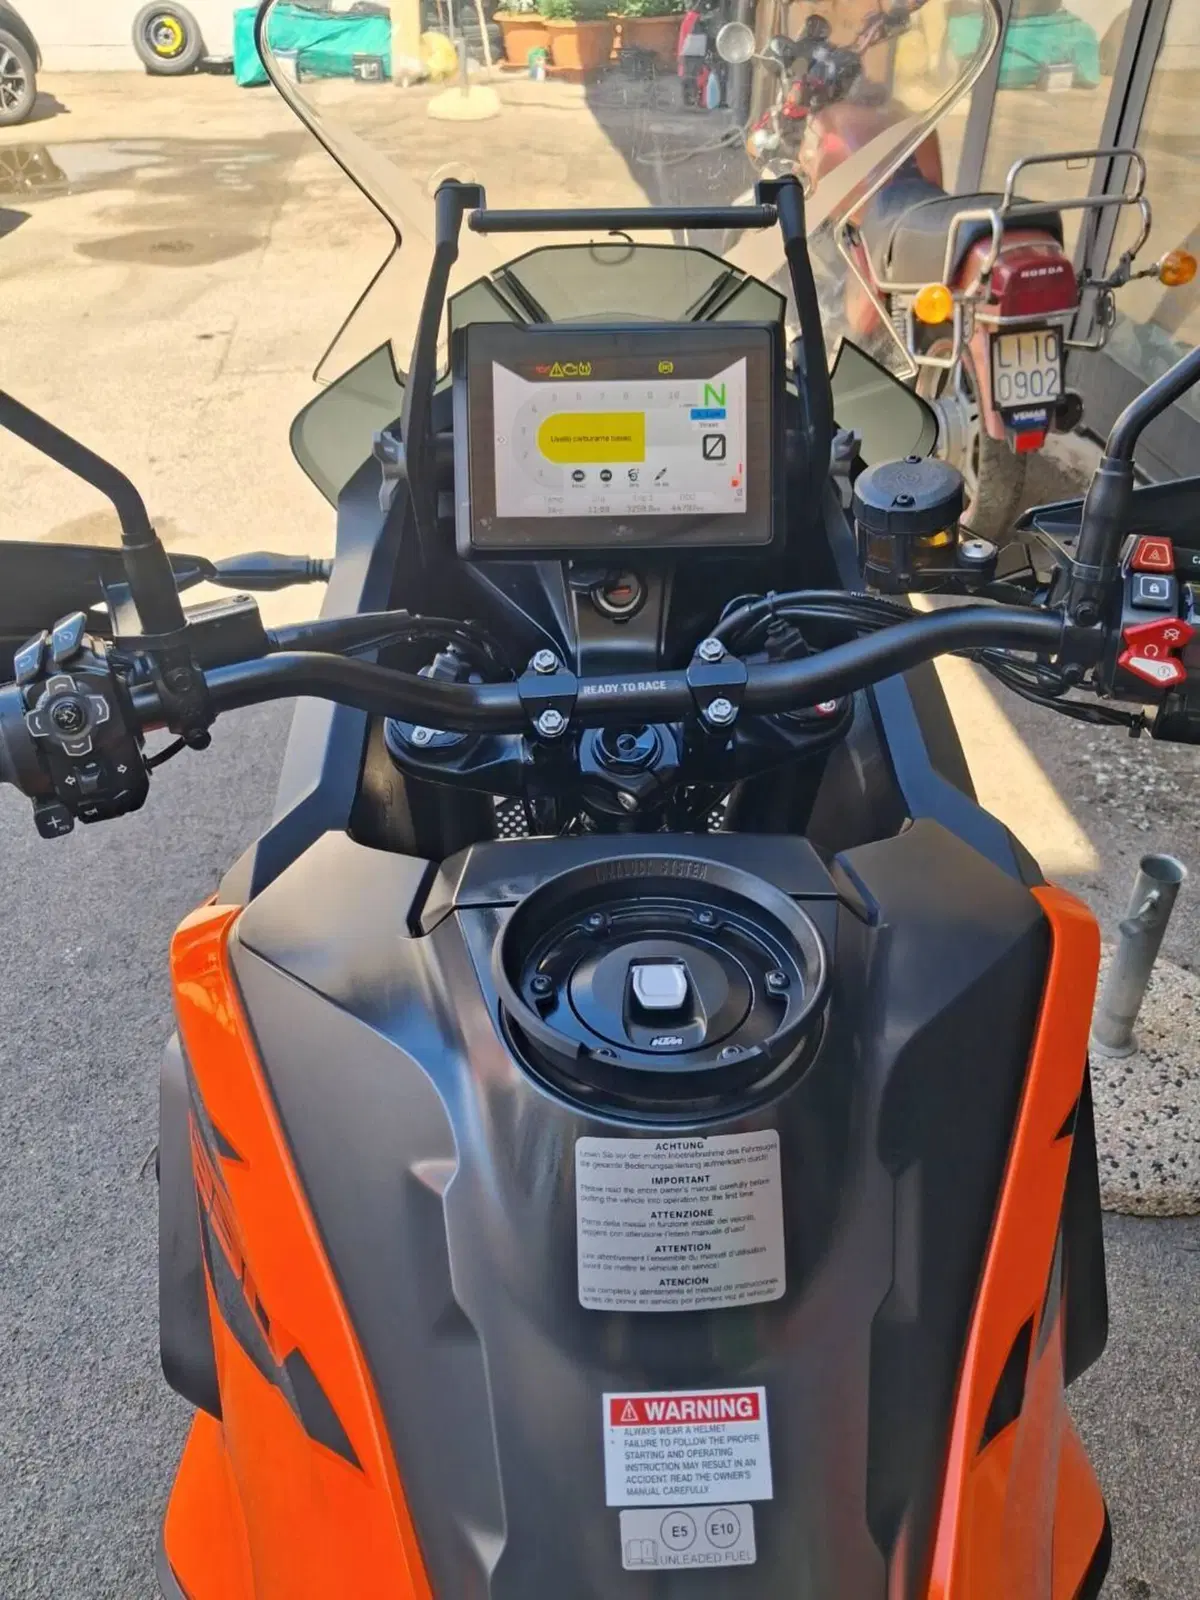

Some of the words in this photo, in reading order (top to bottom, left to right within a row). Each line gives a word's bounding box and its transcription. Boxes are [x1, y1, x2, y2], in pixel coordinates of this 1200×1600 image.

[1020, 266, 1064, 278] HONDA
[998, 368, 1058, 401] 0902
[704, 382, 726, 408] N
[583, 684, 618, 694] READY
[620, 682, 636, 692] TO
[638, 680, 666, 690] RACE
[651, 1036, 683, 1046] KTM
[655, 1142, 704, 1150] ACHTUNG
[651, 1175, 710, 1184] IMPORTANT
[650, 1208, 714, 1219] ATTENZIONE
[654, 1243, 712, 1252] ATTENTION
[644, 1397, 753, 1421] WARNING
[624, 1427, 657, 1436] ALWAYS
[659, 1426, 684, 1435] WEAR
[685, 1426, 692, 1434] A
[694, 1424, 726, 1434] HELMET
[624, 1438, 658, 1448] FAILURE
[660, 1438, 671, 1447] TO
[673, 1437, 706, 1446] FOLLOW
[709, 1436, 724, 1445] THE
[726, 1434, 760, 1444] PROPER
[624, 1451, 664, 1460] STARTING
[667, 1450, 684, 1459] AND
[686, 1448, 734, 1458] OPERATING
[625, 1462, 680, 1472] INSTRUCTION
[682, 1461, 700, 1470] MAY
[702, 1460, 732, 1469] RESULT
[734, 1458, 743, 1467] IN
[744, 1458, 756, 1467] AN
[670, 1473, 693, 1482] READ
[696, 1472, 712, 1482] THE
[713, 1470, 752, 1481] OWNER'S
[626, 1486, 660, 1496] MANUAL
[672, 1526, 688, 1538] E5
[711, 1523, 734, 1536] E10
[660, 1552, 722, 1566] UNLEADED
[724, 1550, 752, 1562] FUEL
